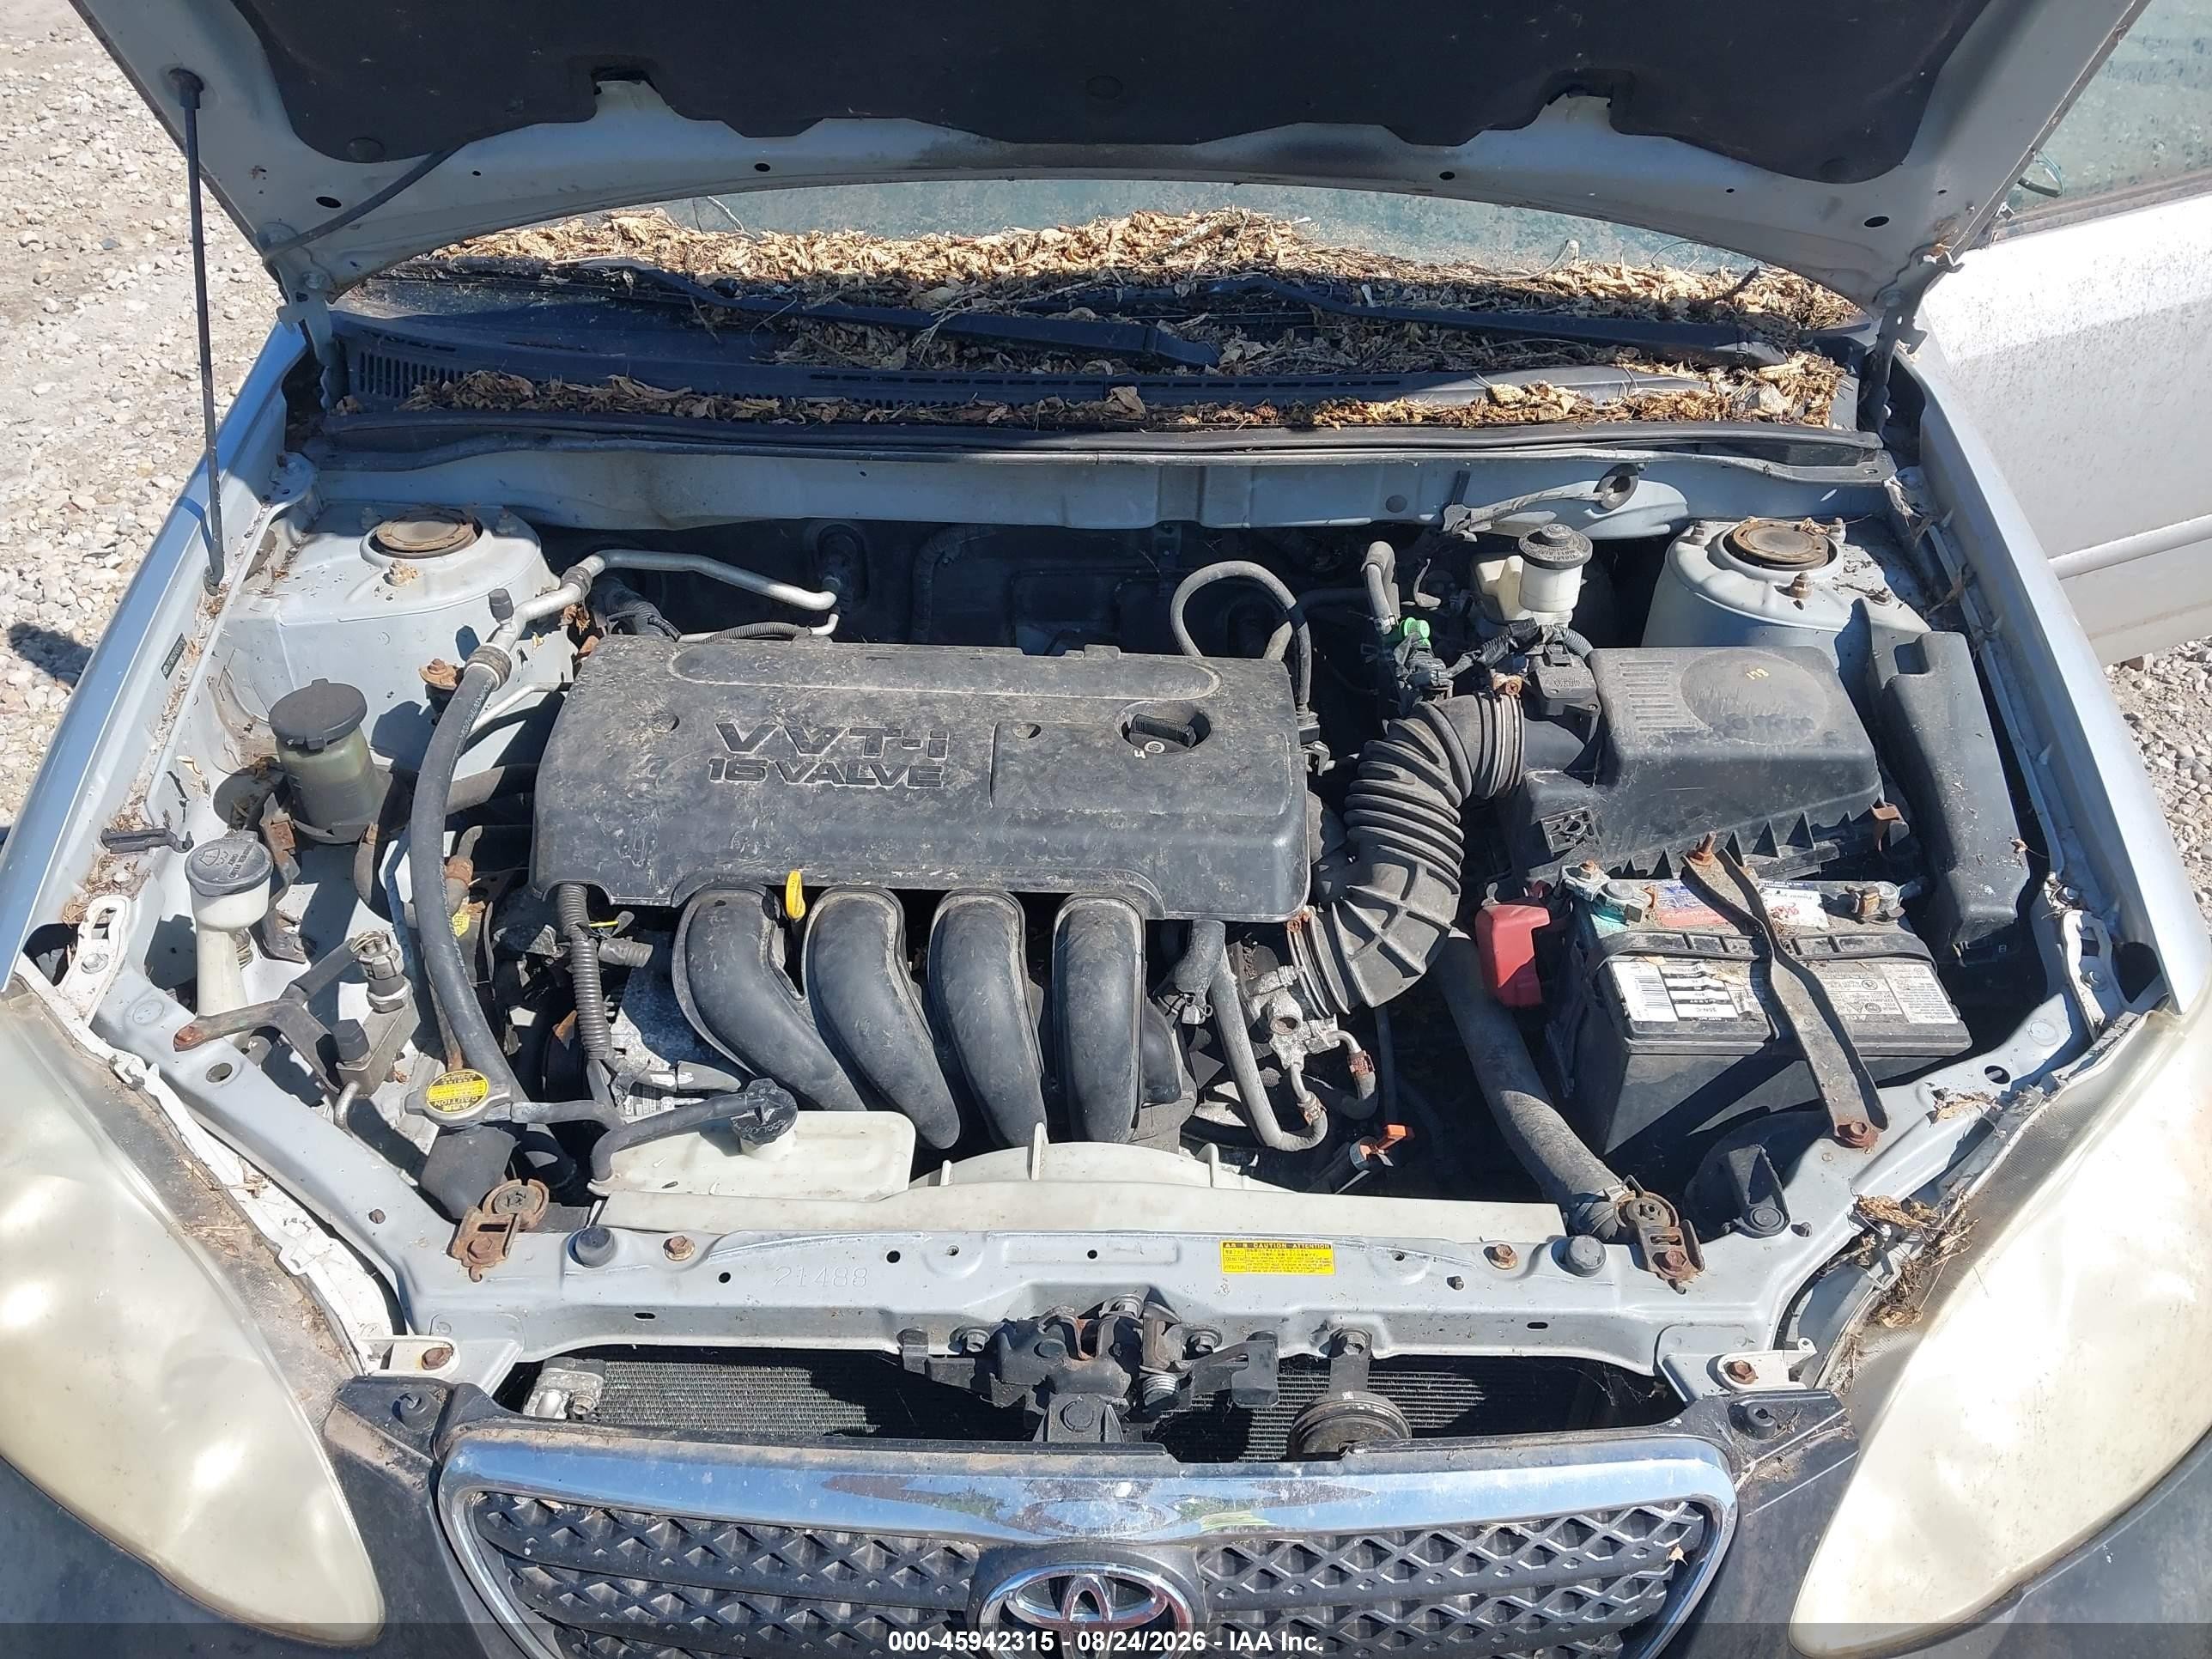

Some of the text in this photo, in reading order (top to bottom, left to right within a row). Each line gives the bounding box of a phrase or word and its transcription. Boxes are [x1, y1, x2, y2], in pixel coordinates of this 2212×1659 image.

[708, 757, 944, 788] 16 VALVE
[434, 1096, 479, 1107] CAUTION
